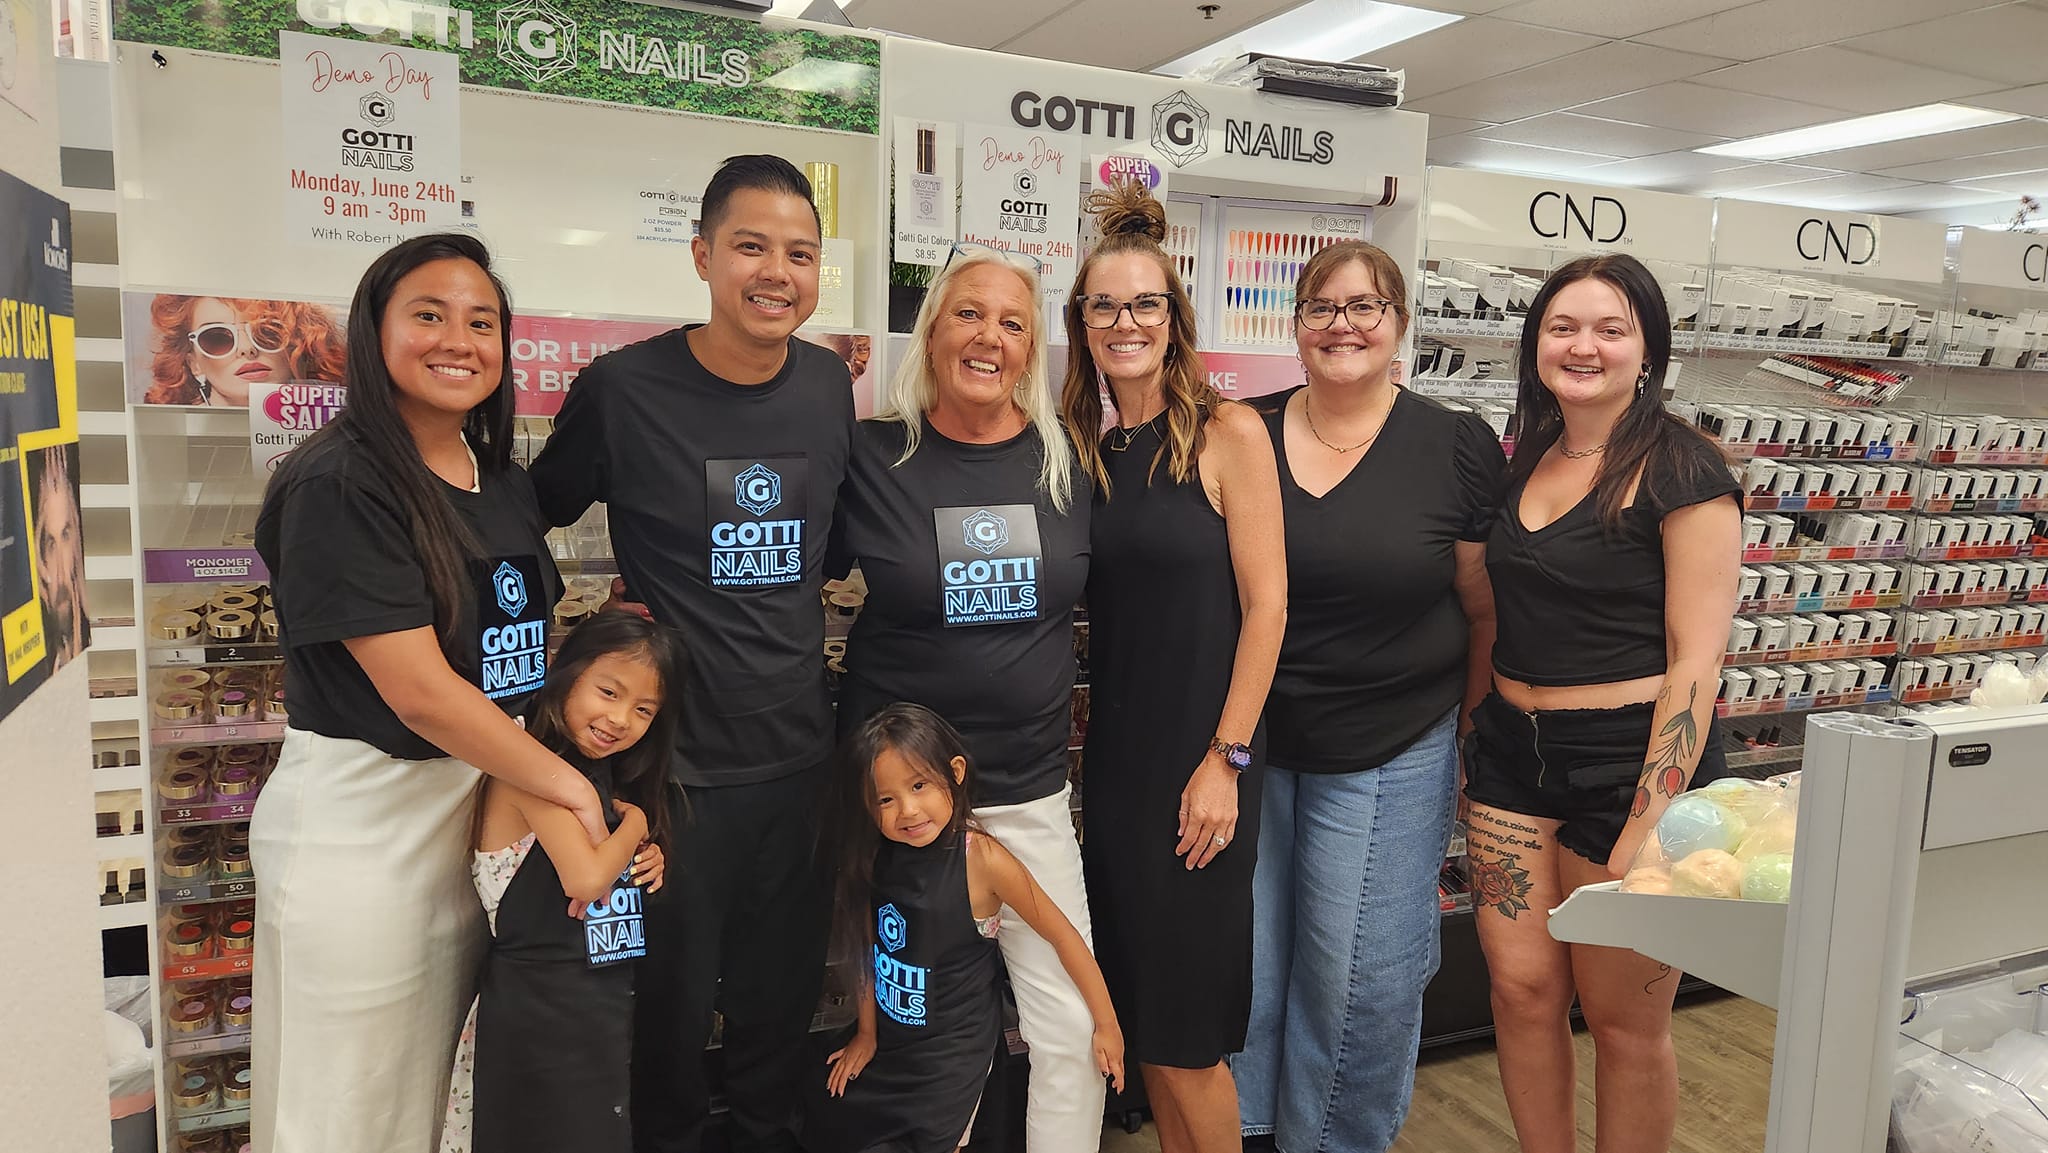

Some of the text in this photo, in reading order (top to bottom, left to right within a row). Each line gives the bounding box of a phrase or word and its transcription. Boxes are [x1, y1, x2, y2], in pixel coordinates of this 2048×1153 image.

[296, 0, 751, 88] GOTTI G NAILS
[305, 50, 435, 100] Demo Day
[368, 102, 386, 118] G
[1010, 91, 1335, 165] GOTTI G NAILS
[342, 128, 413, 151] GOTTI
[342, 149, 414, 172] NAILS
[980, 136, 1065, 175] Demo Day
[1108, 155, 1151, 174] SUPER
[291, 169, 455, 203] Monday, June 24th
[640, 191, 665, 200] GOTTI
[324, 196, 335, 216] 9
[342, 203, 368, 218] am
[388, 202, 426, 225] 3pm
[1000, 199, 1047, 217] GOTTI
[1529, 191, 1627, 244] CND
[1000, 216, 1047, 233] NAILS
[1328, 218, 1361, 229] GOTTI
[311, 227, 342, 240] With
[347, 230, 392, 244] Robert
[898, 232, 954, 246] Gotti Gel Colors
[1796, 218, 1876, 265] CND
[915, 248, 937, 260] $8.95
[1046, 240, 1073, 258] 24th
[20, 302, 49, 360] USA
[280, 385, 348, 406] SUPER
[255, 433, 284, 445] Gotti
[747, 478, 770, 501] G
[711, 520, 801, 547] GOTTI
[974, 521, 997, 541] G
[186, 558, 253, 567] MONOMER
[711, 549, 801, 577] NAILS
[944, 557, 1036, 585] GOTTI
[502, 577, 519, 602] G
[713, 574, 801, 586] WWW.GOTTINAILS.COM
[945, 585, 1038, 615] NAILS
[947, 610, 1038, 624] WWW.GOTTINAILS.COM
[482, 620, 545, 655] GOTTI
[228, 648, 236, 656] 2
[482, 652, 545, 692] NAILS
[225, 727, 237, 735] 18
[1954, 746, 1989, 754] TENSATOR
[177, 805, 245, 818] 33 34
[176, 884, 244, 897] 49 50
[883, 916, 898, 940] G
[182, 959, 249, 974] 65 66
